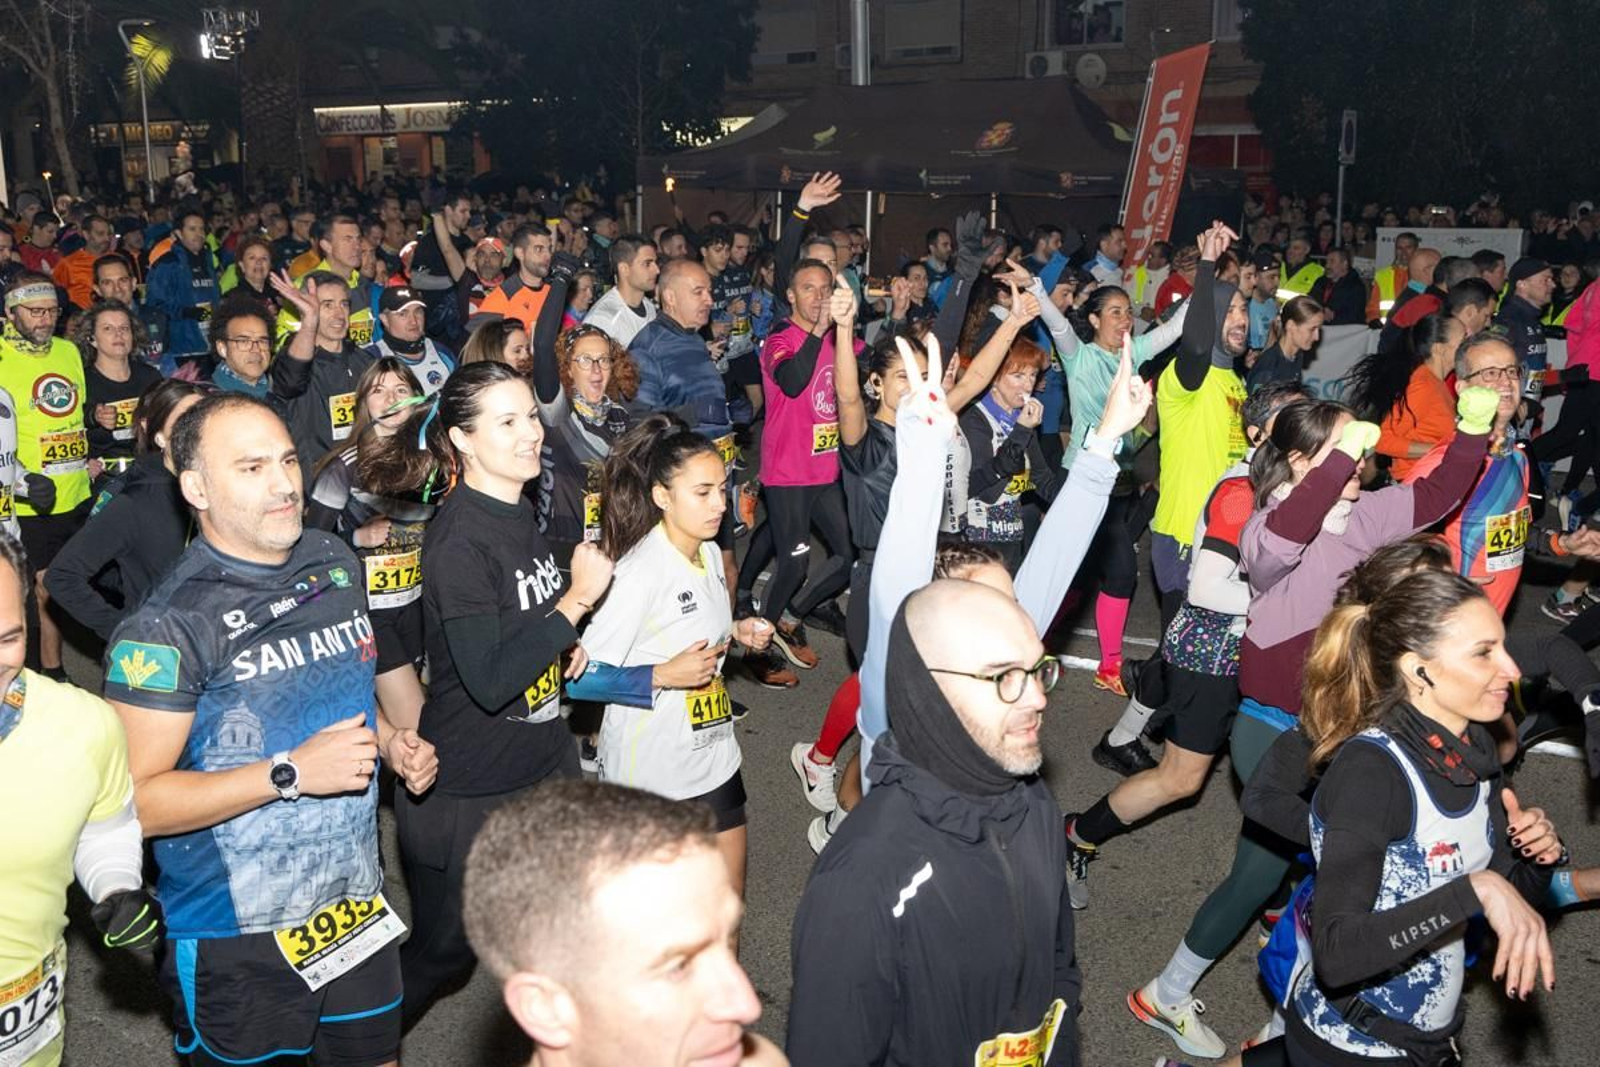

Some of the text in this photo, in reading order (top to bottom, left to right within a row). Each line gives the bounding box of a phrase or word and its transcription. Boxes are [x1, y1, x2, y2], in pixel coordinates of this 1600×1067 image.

[45, 440, 86, 460] 4363
[0, 497, 11, 516] 4
[945, 453, 956, 531] Fondistas
[374, 565, 422, 589] 3175
[515, 552, 564, 611] inde
[232, 636, 306, 681] SAN
[692, 692, 730, 721] 4110
[1388, 913, 1452, 950] KIPSTA
